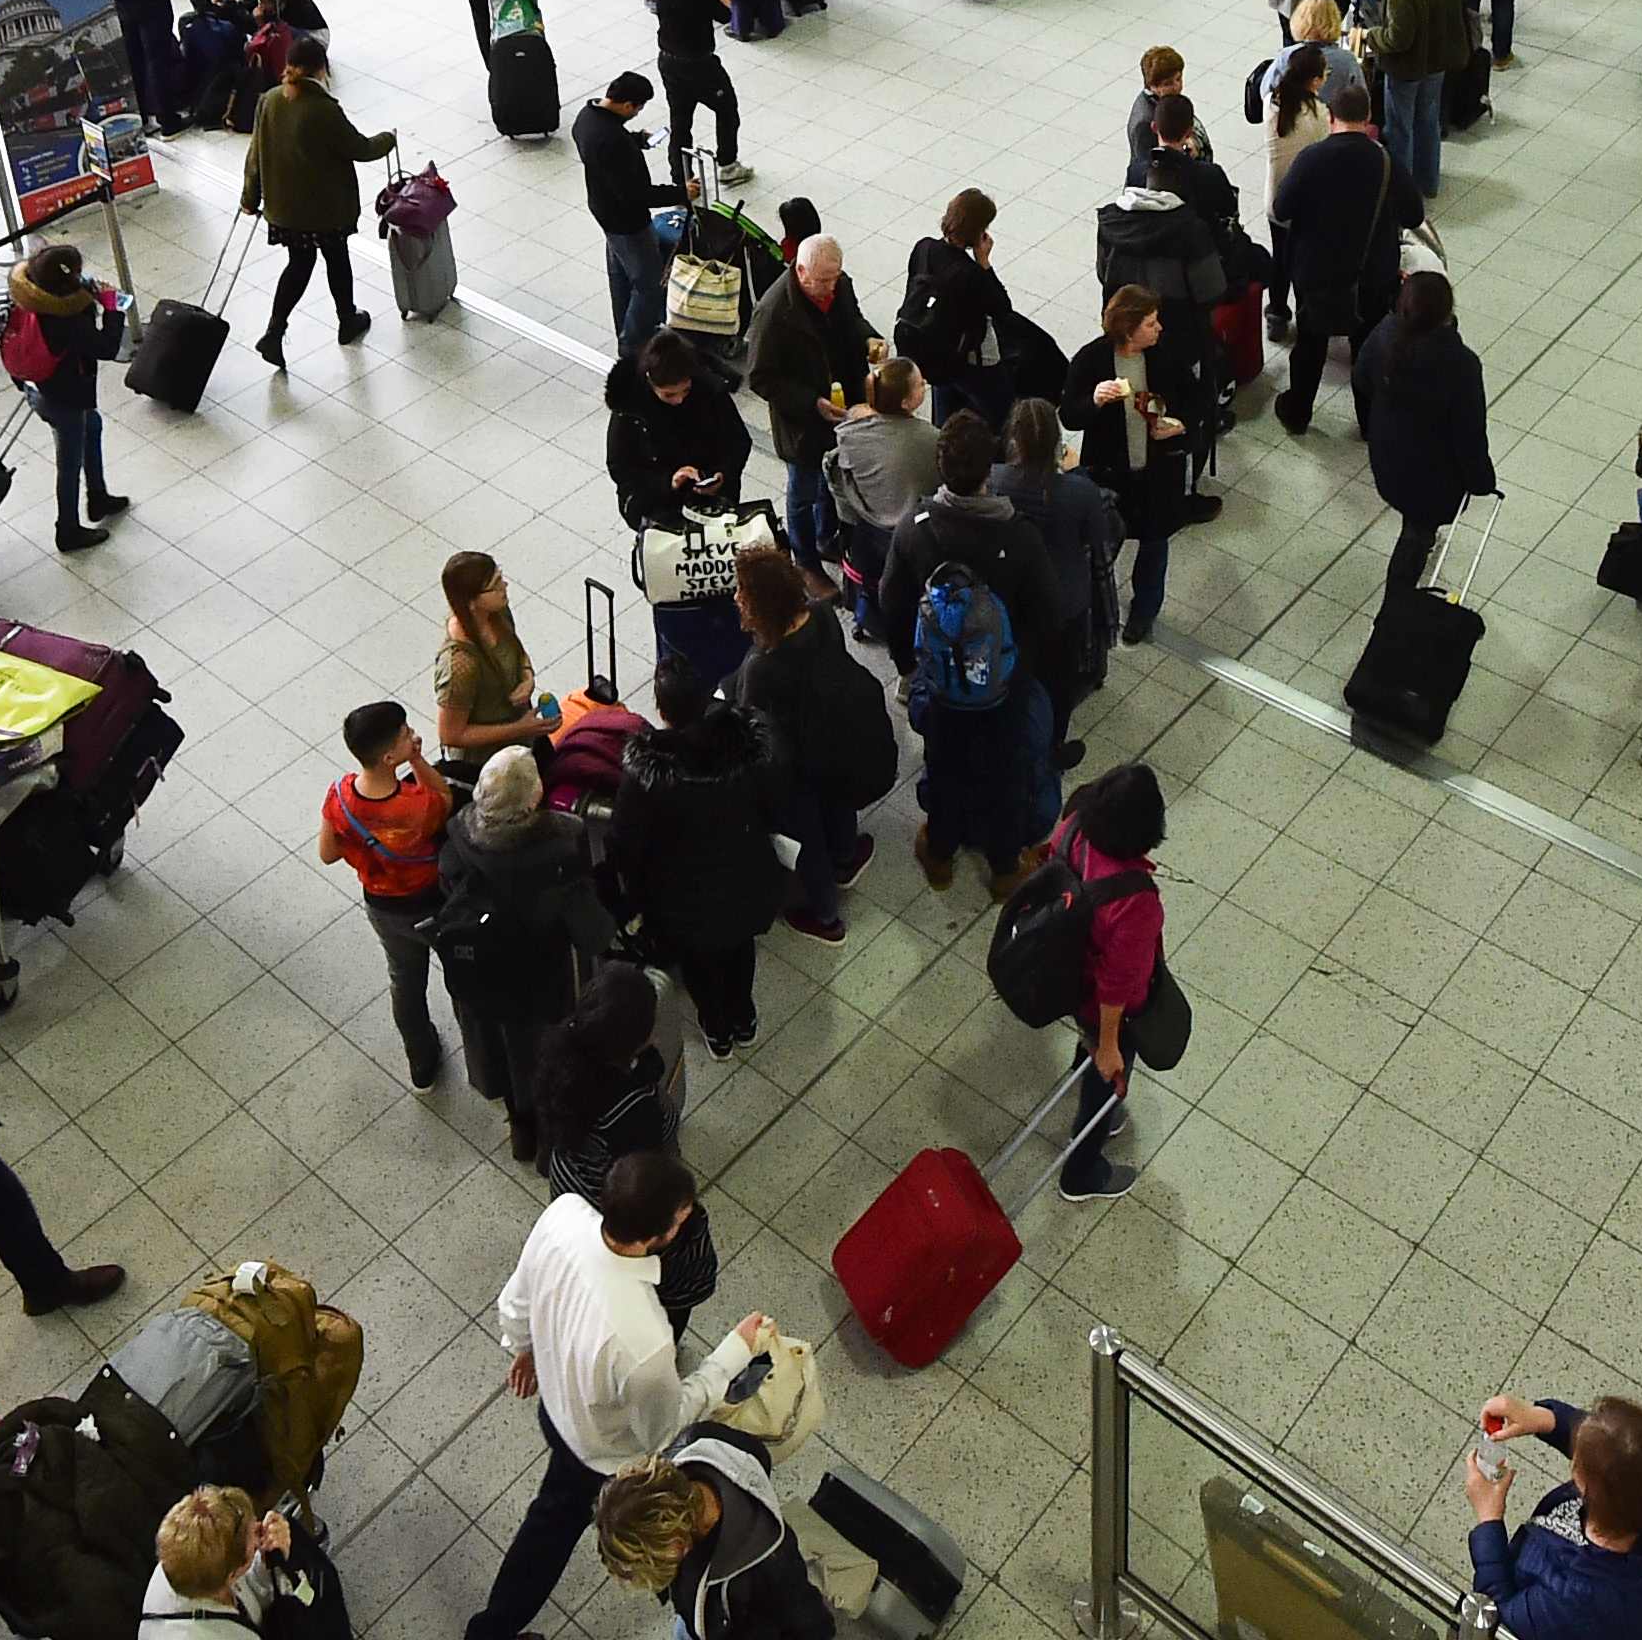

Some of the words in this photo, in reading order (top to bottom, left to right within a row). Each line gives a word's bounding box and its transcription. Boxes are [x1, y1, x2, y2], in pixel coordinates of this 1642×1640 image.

[682, 542, 741, 561] STEVE
[676, 559, 737, 577] MADDE
[685, 575, 735, 590] STEV
